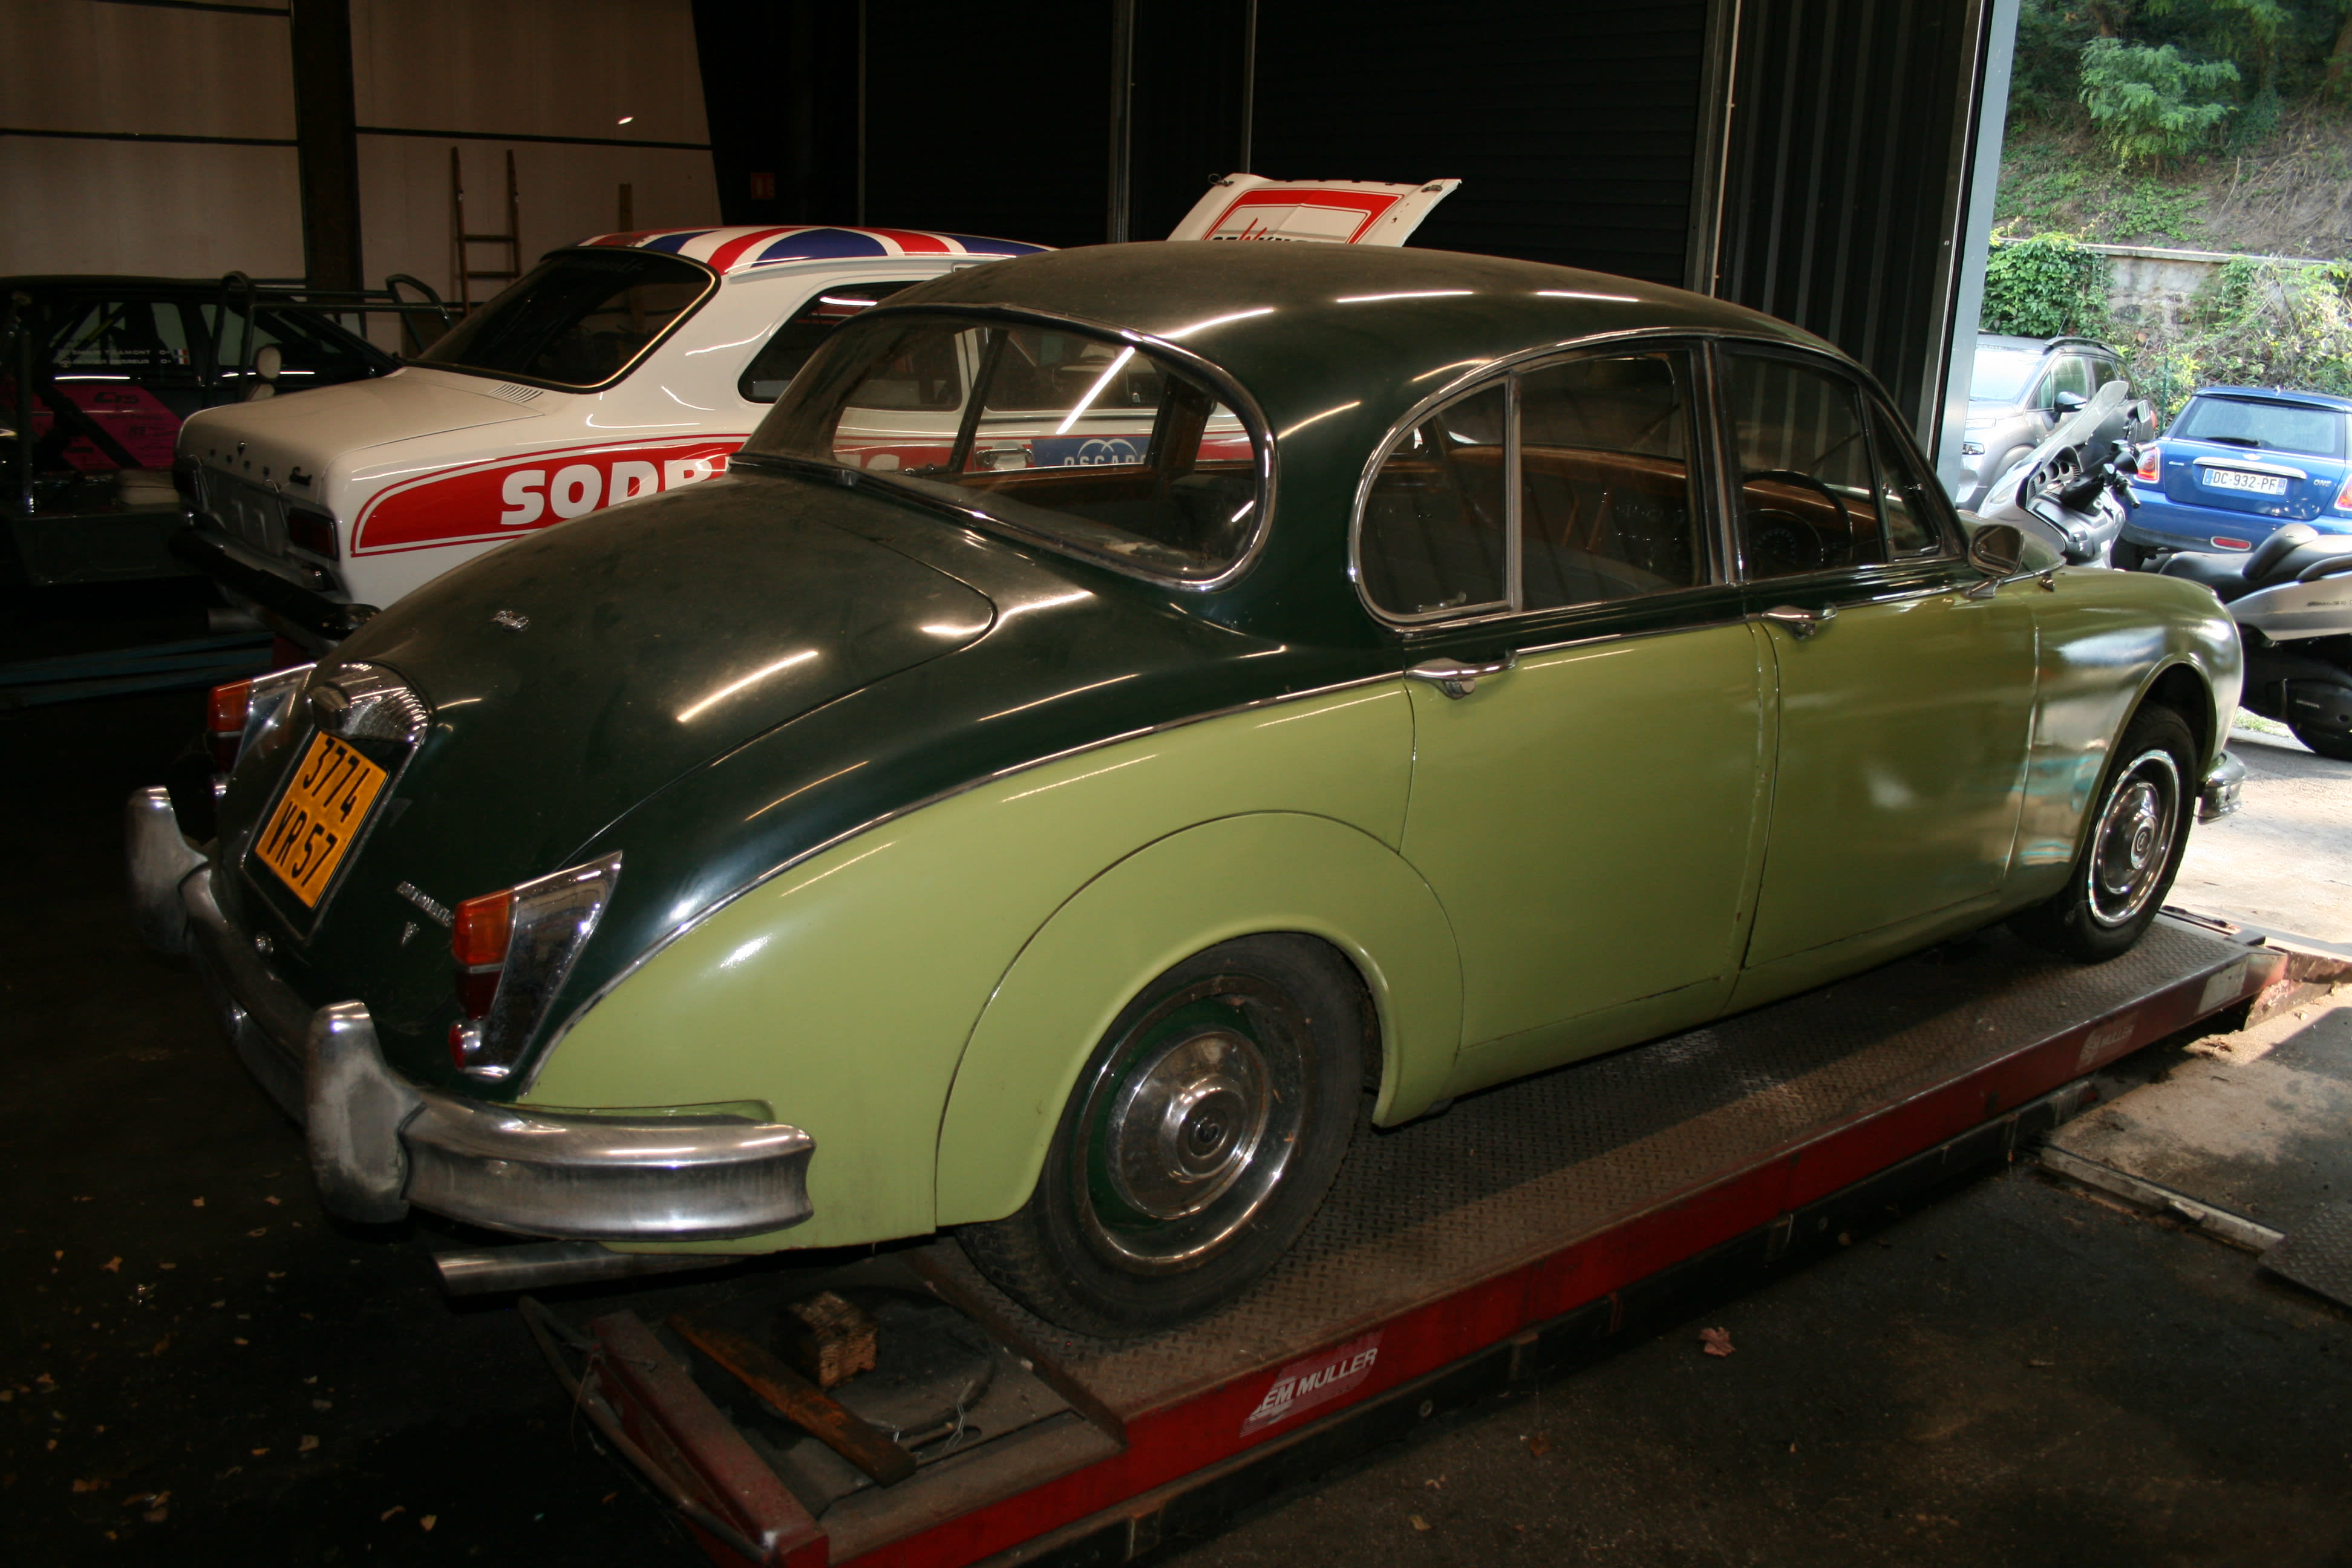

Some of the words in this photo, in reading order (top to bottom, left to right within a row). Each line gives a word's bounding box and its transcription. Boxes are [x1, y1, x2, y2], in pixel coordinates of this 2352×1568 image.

[2313, 479, 2333, 487] ONE
[303, 736, 371, 823] 3774
[1296, 1347, 1378, 1397] MULLER
